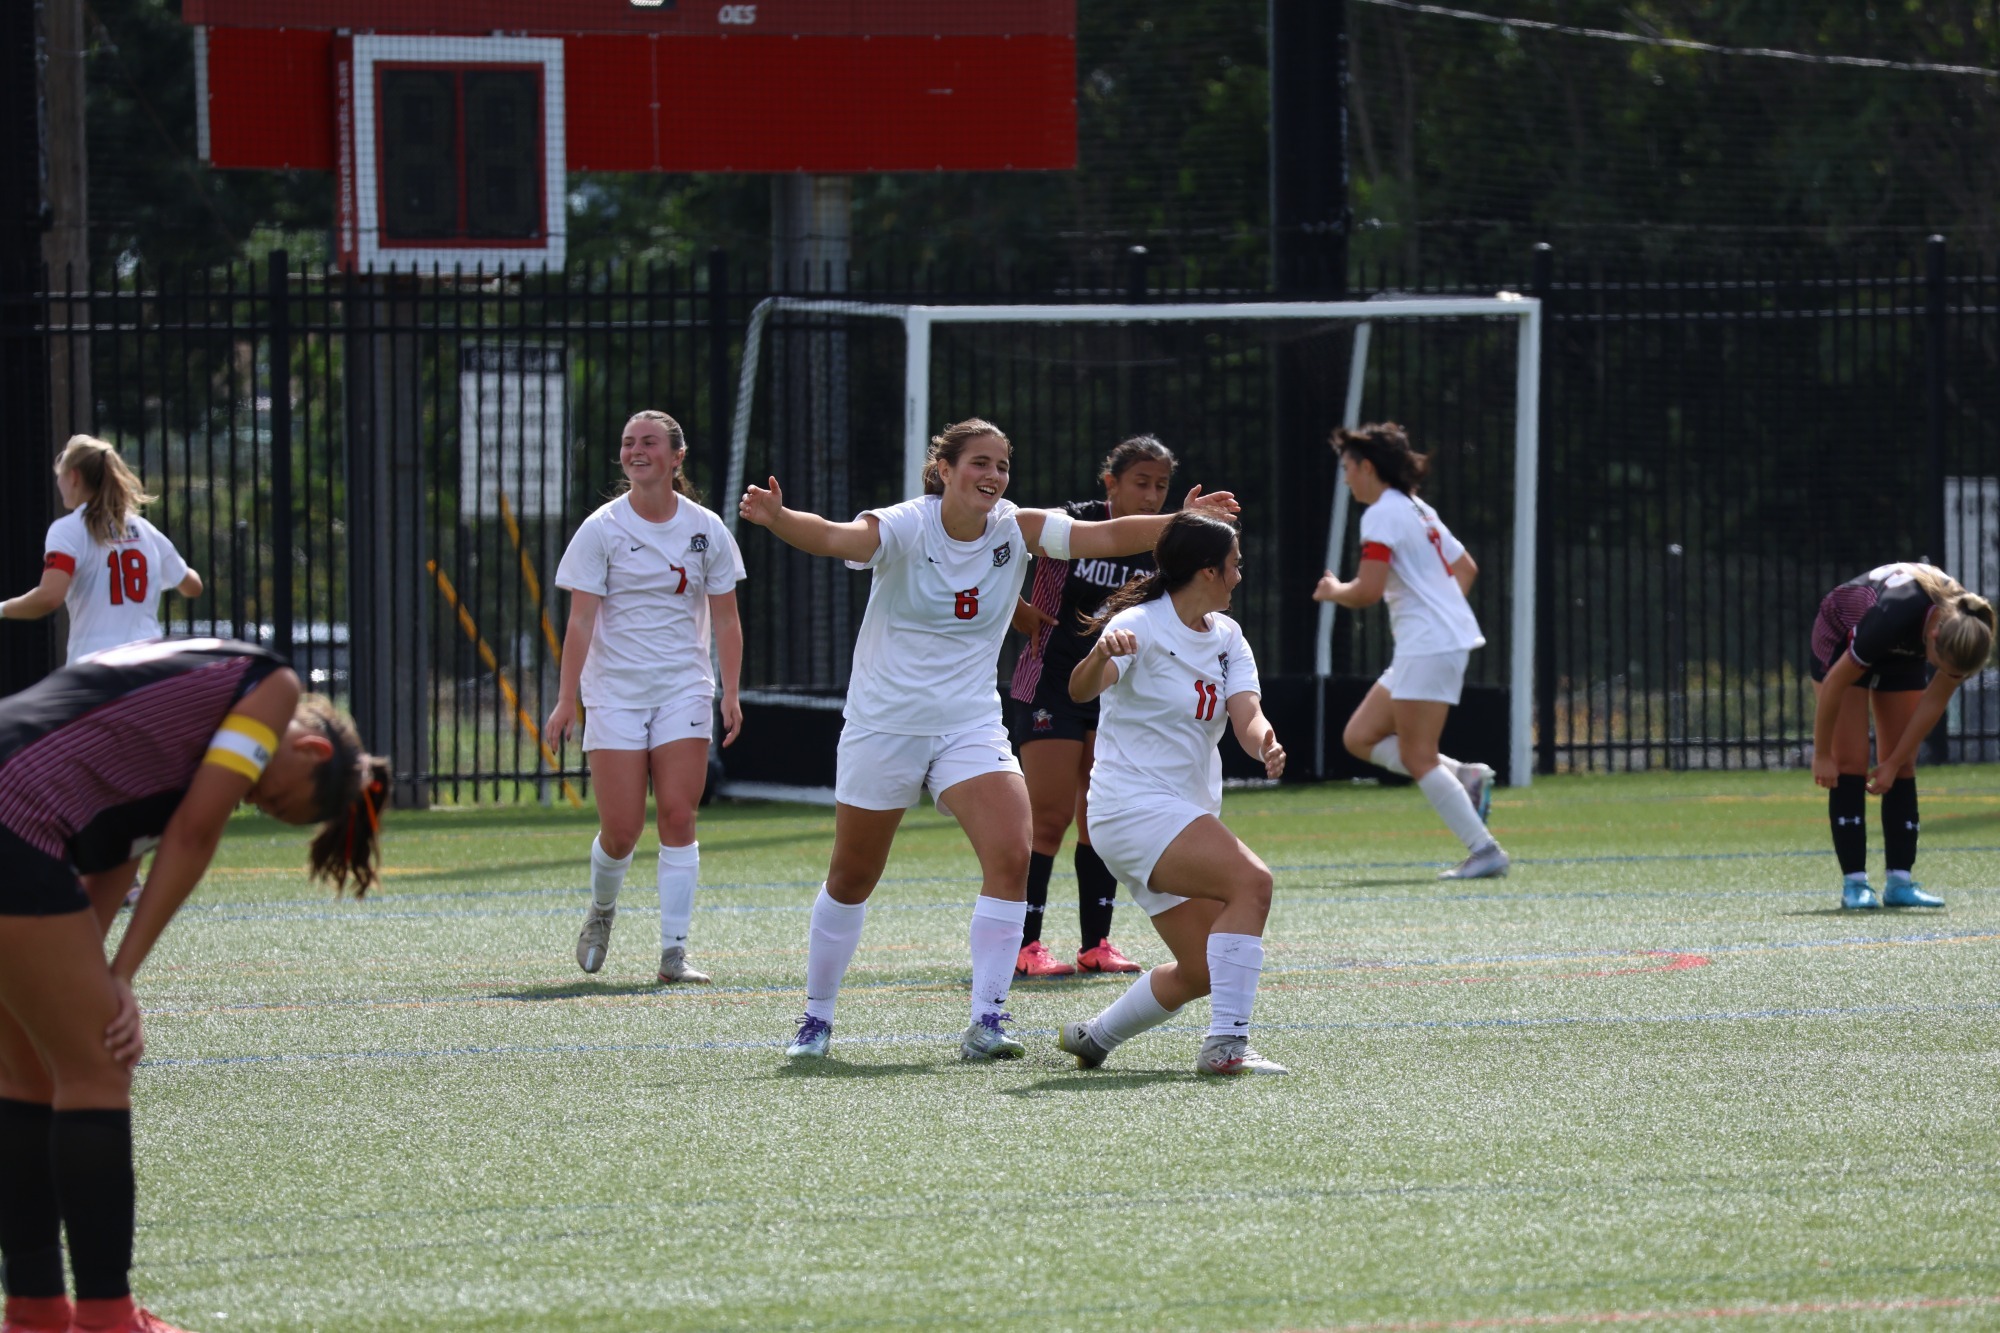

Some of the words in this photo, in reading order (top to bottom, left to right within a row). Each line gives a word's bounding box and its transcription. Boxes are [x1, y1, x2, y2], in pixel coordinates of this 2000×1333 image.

[718, 4, 757, 25] OES
[107, 548, 148, 605] 18
[669, 563, 689, 595] 7
[954, 586, 980, 621] 6
[1193, 679, 1218, 722] 11
